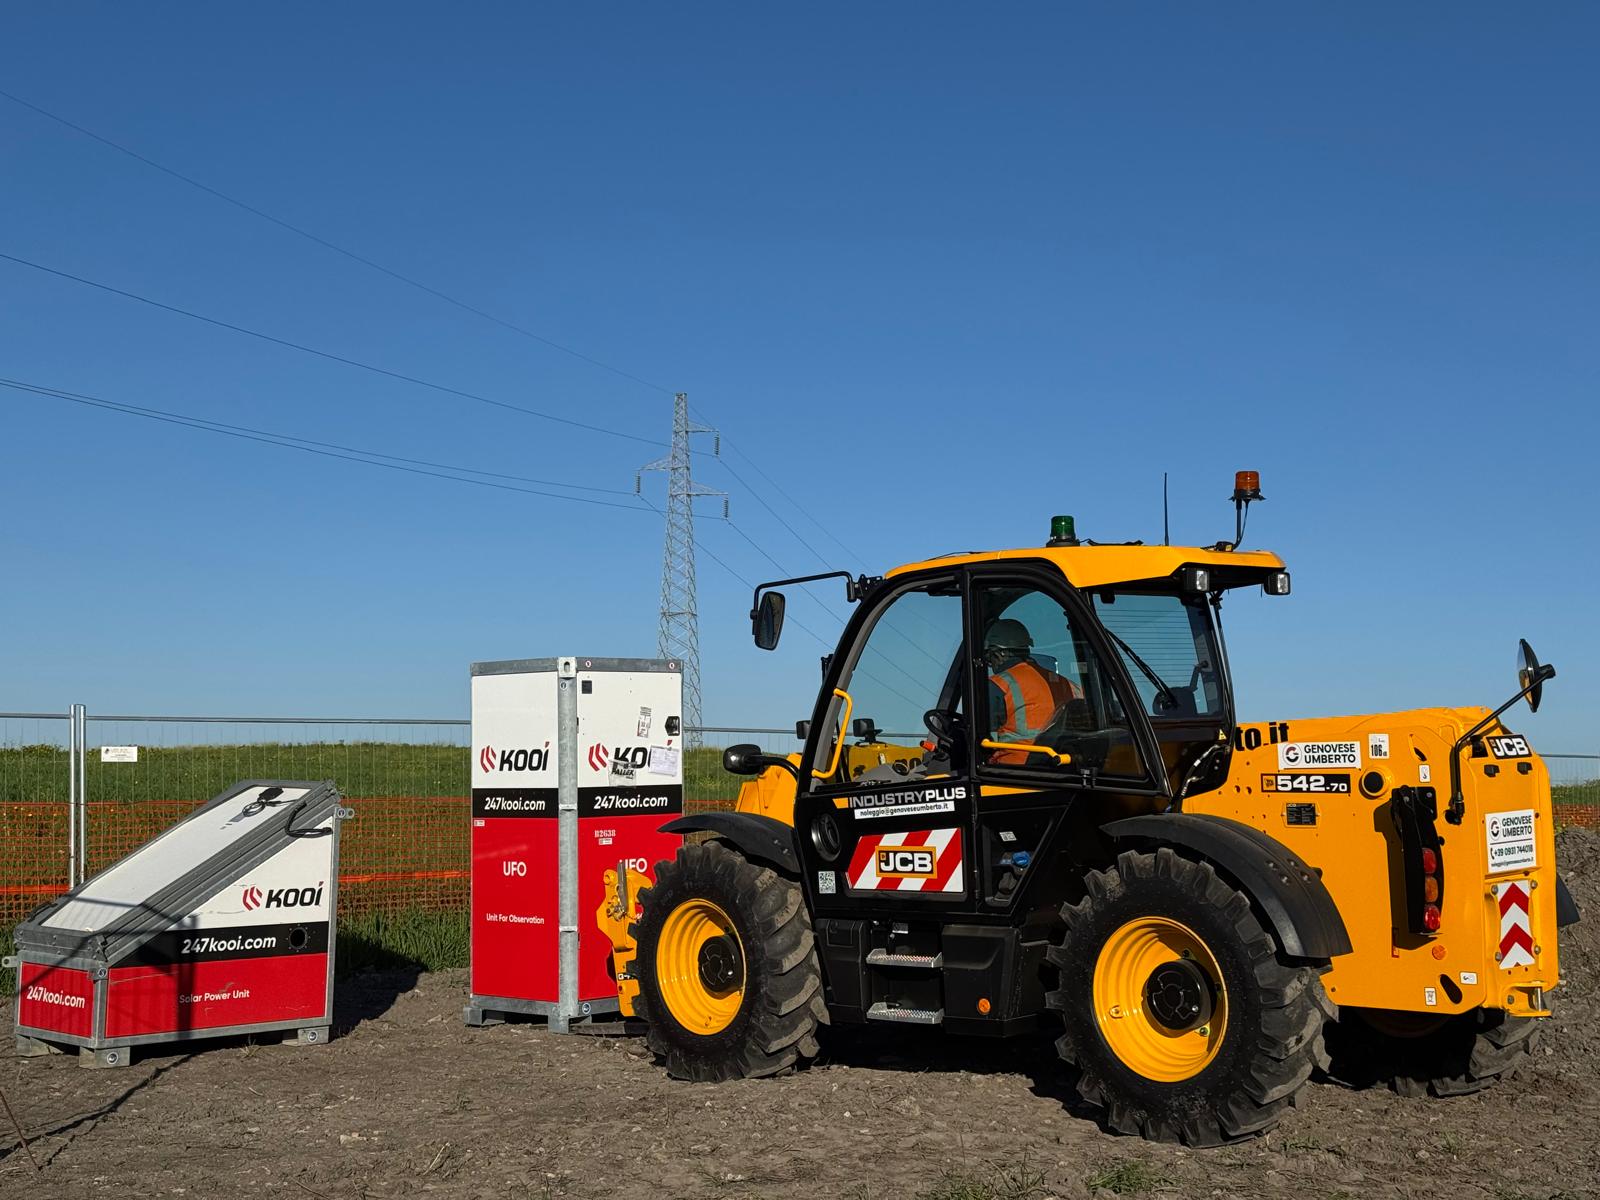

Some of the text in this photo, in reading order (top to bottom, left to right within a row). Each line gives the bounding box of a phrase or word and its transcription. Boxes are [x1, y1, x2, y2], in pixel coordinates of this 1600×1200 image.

[1304, 743, 1356, 753] GENOVESE
[1493, 737, 1529, 756] JCB
[1304, 754, 1356, 764] UMBERTO
[484, 796, 546, 811] 247kooi.com
[593, 795, 668, 810] 247kooi.com
[1502, 815, 1532, 827] GENOVESE
[1502, 825, 1533, 837] UMBERTO
[503, 860, 527, 877] UFO
[880, 852, 933, 872] JCB
[486, 913, 545, 925] Unit For Observation
[181, 935, 277, 954] 247kooi.com
[27, 985, 86, 1009] 247kooi.com
[179, 989, 250, 1004] Solar Power Unit
